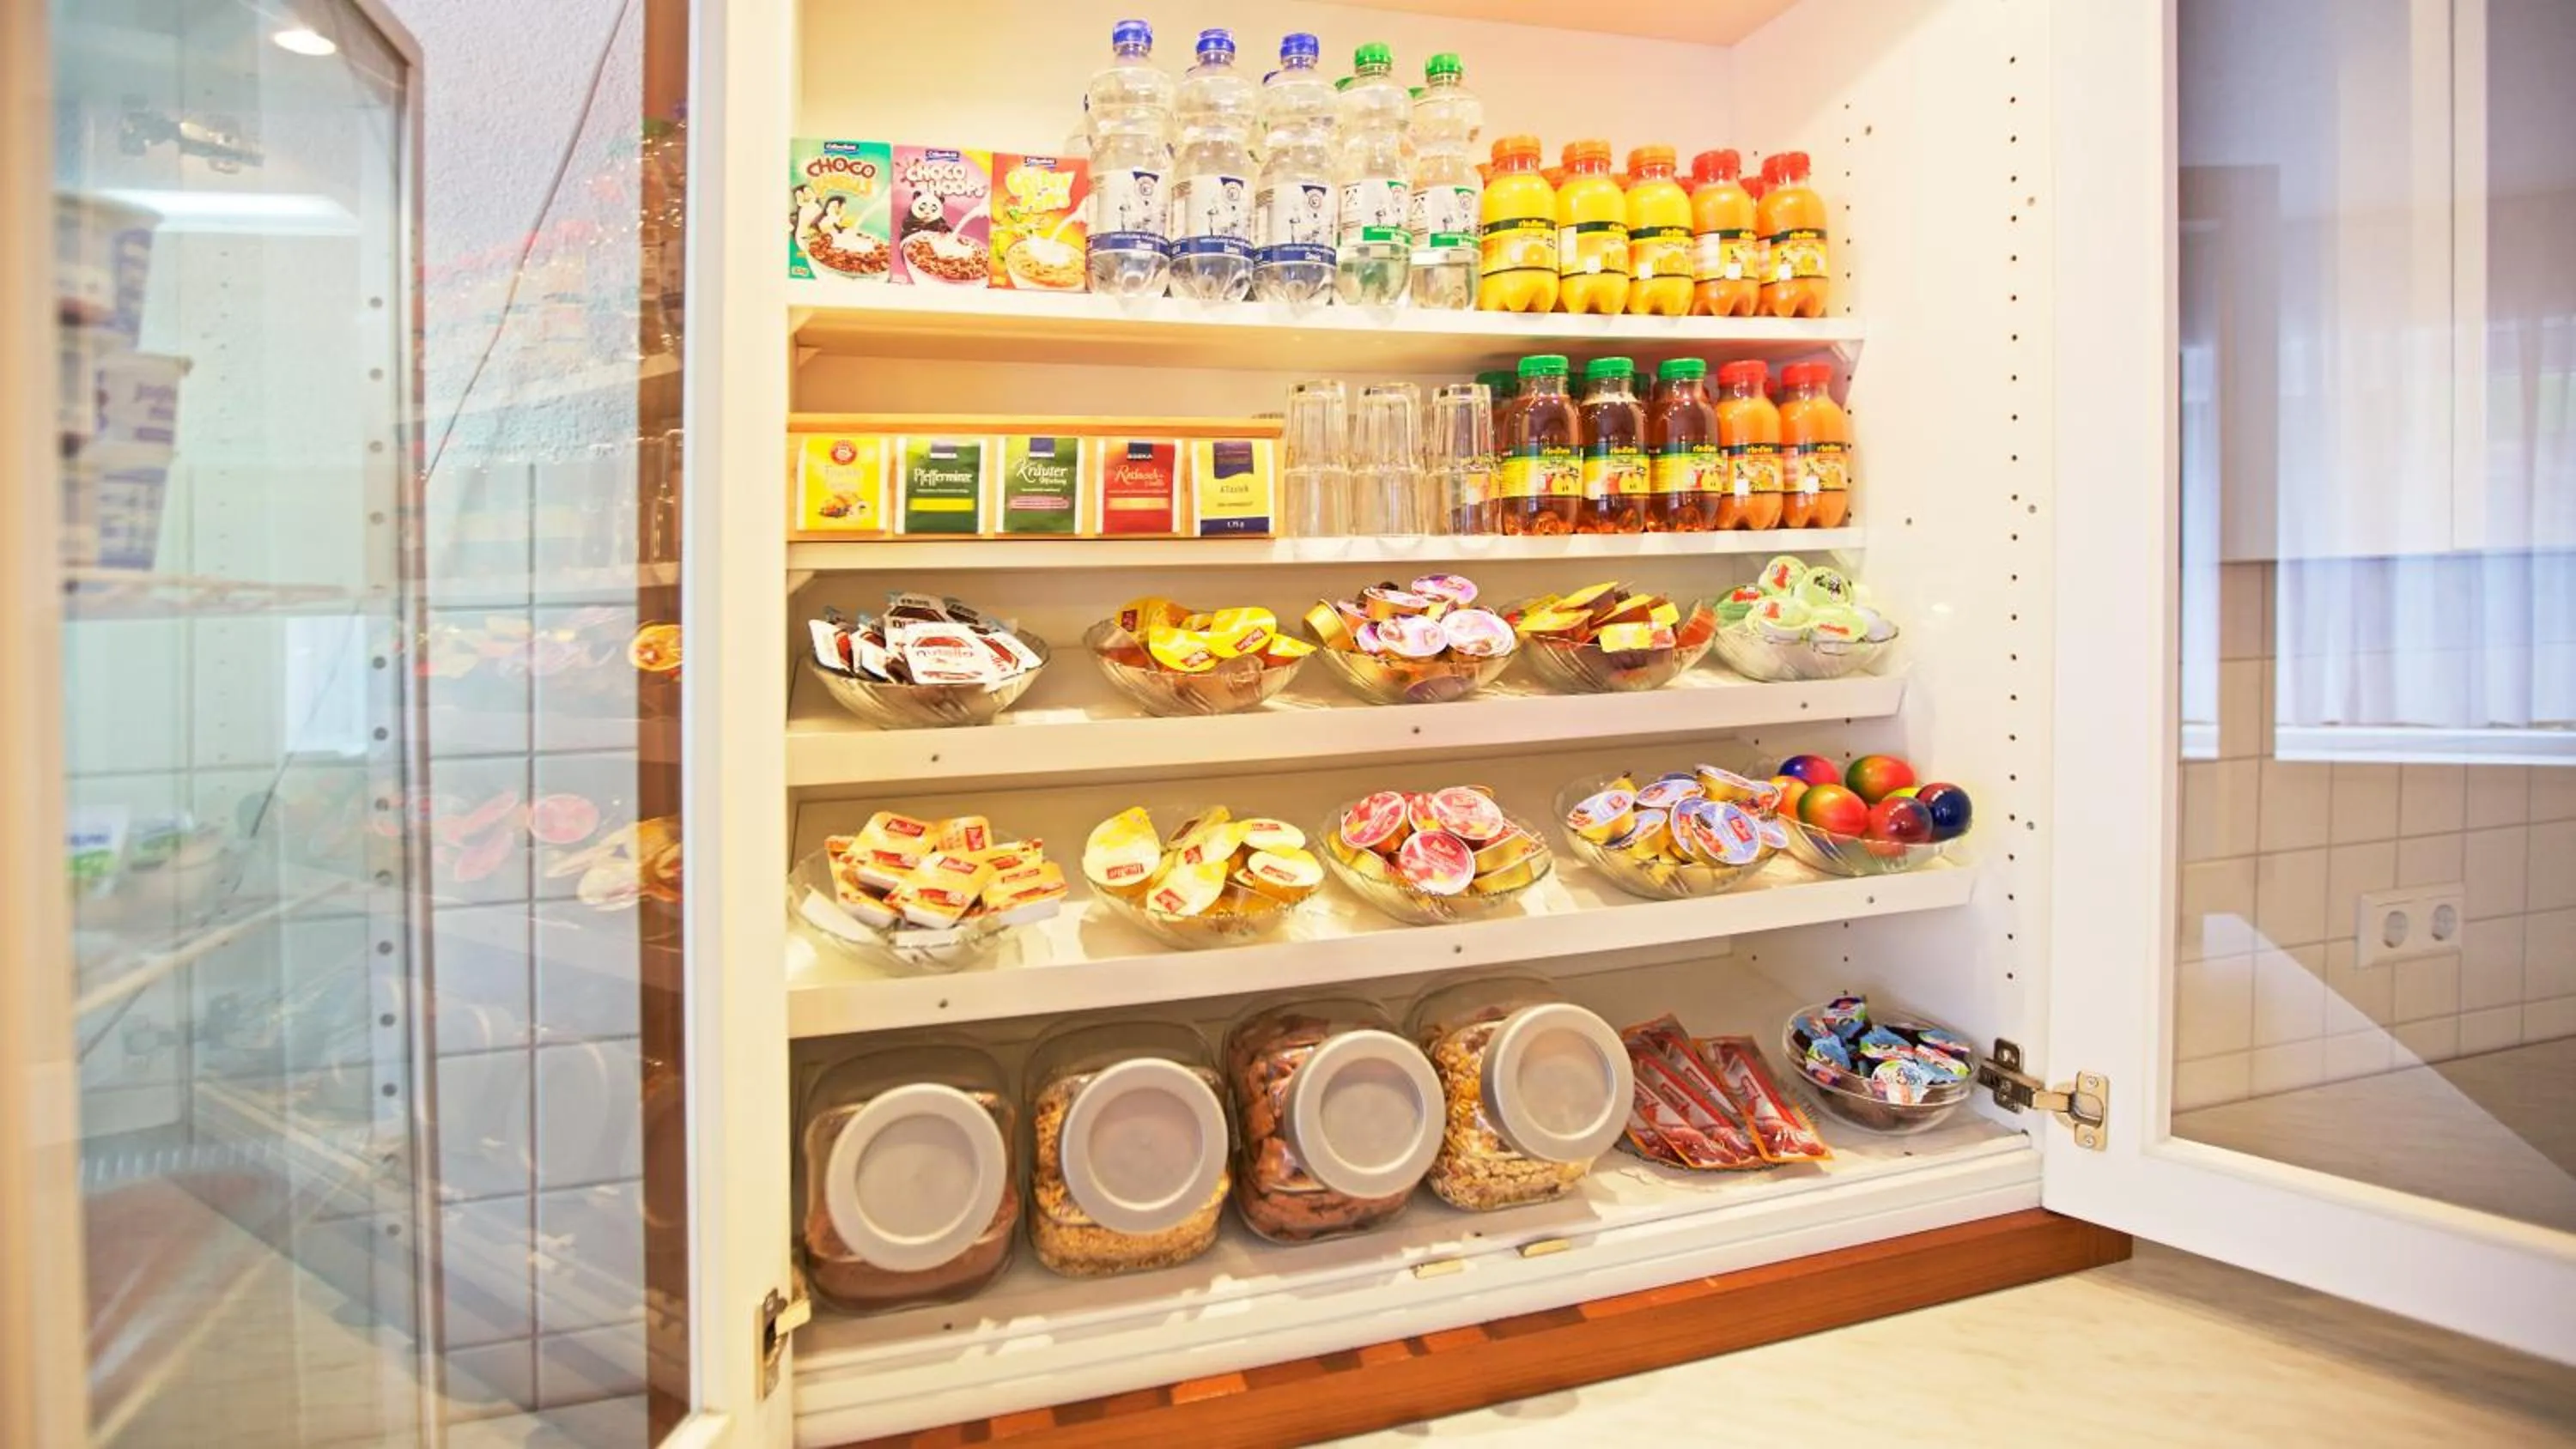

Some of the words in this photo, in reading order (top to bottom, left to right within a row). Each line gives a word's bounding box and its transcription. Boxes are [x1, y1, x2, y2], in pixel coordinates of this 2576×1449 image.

[806, 157, 876, 179] CHOCO
[906, 164, 967, 181] CHOCO
[1012, 456, 1068, 483] Kräuter
